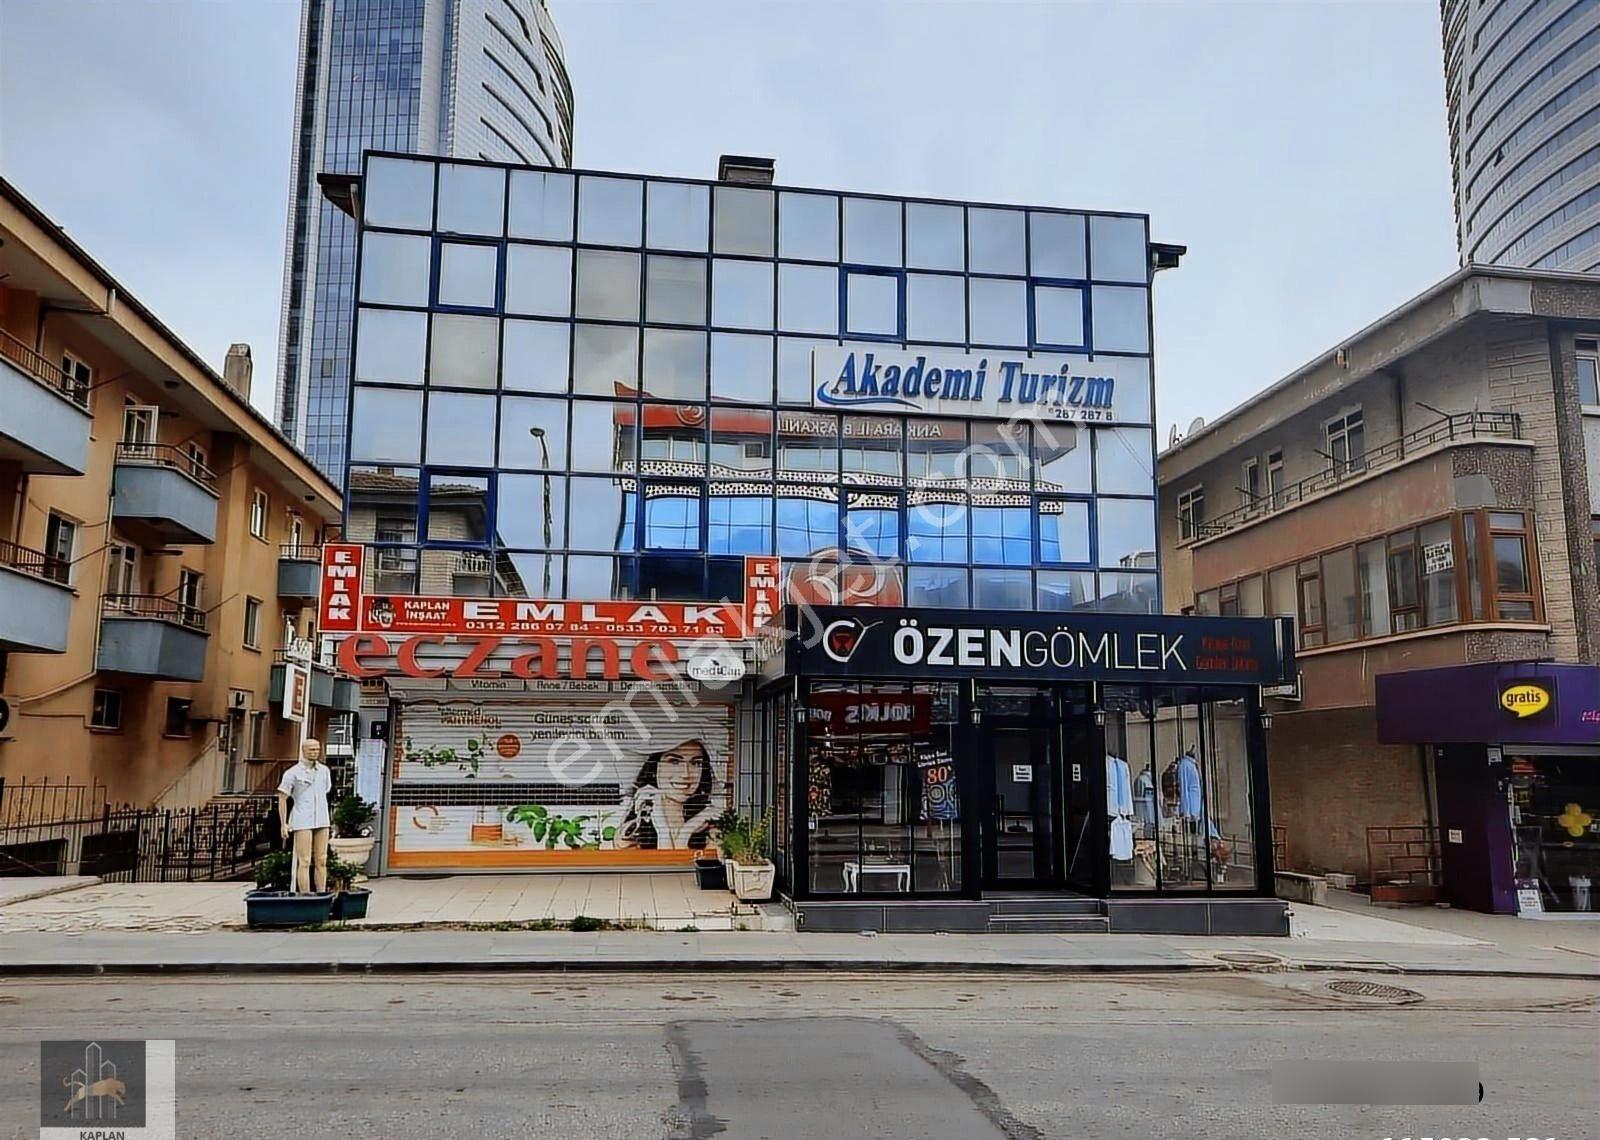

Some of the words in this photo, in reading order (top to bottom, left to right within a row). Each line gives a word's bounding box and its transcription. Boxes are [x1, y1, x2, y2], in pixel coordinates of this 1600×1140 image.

[831, 352, 988, 401] Akademi
[997, 361, 1115, 409] Turizm
[327, 551, 356, 620] EMLAK
[749, 562, 775, 629] EMLAK
[404, 600, 450, 611] KAPLAN
[463, 601, 725, 625] EMLAK
[466, 621, 506, 630] 0312
[545, 622, 564, 631] 07
[338, 633, 679, 680] eczane
[1506, 690, 1541, 707] gratis
